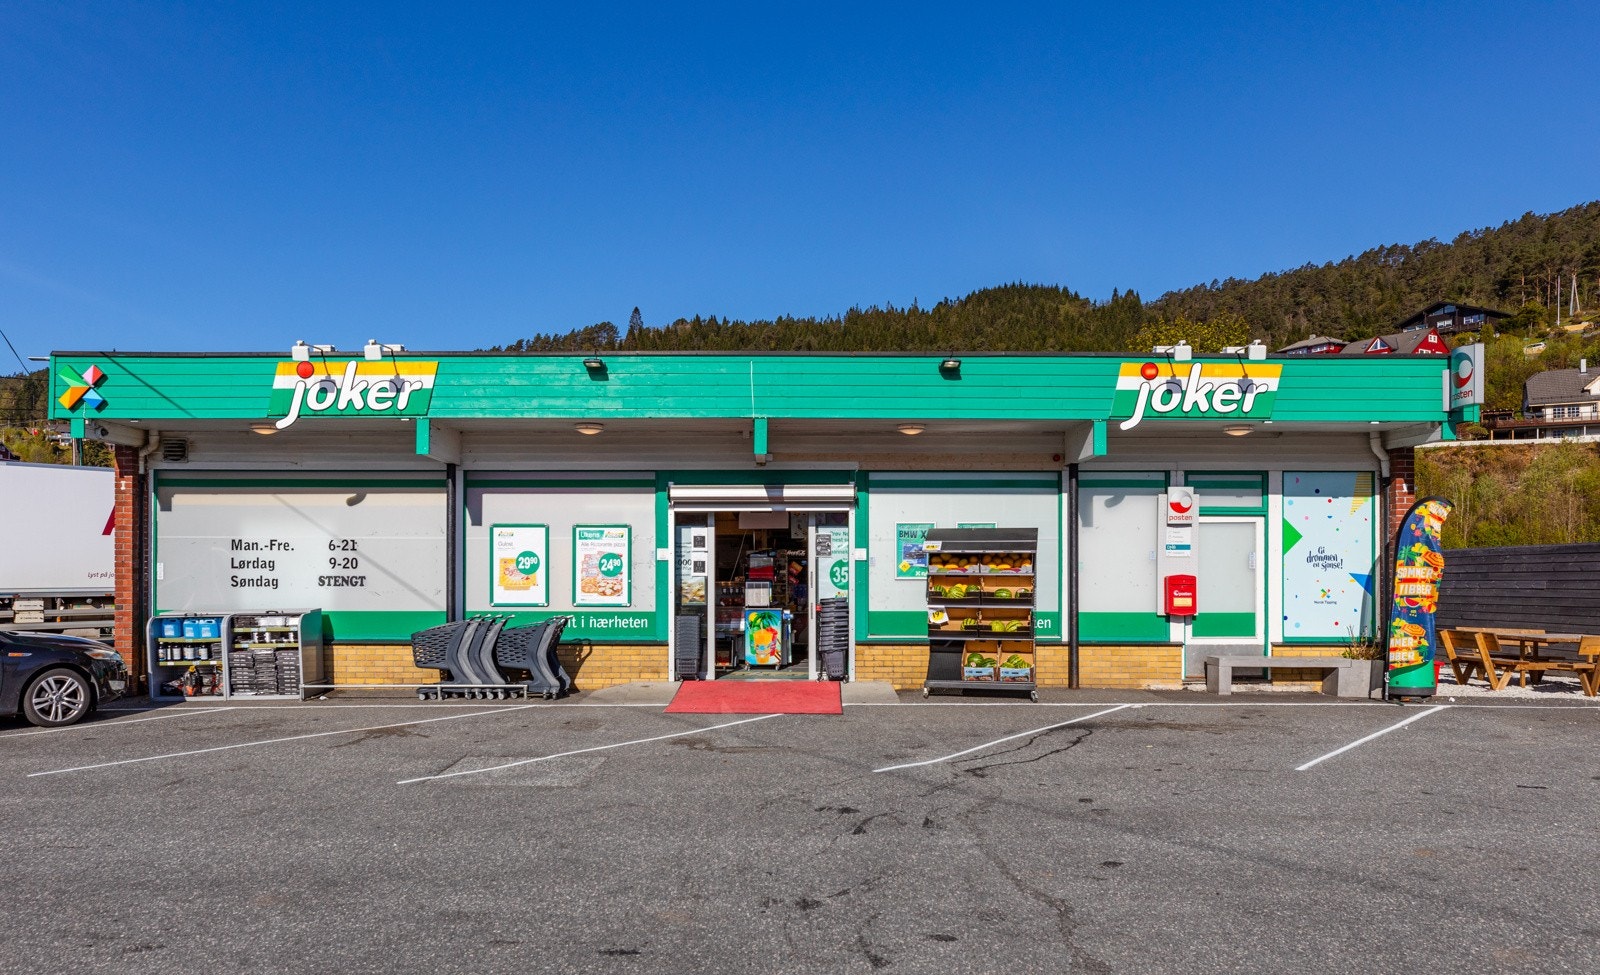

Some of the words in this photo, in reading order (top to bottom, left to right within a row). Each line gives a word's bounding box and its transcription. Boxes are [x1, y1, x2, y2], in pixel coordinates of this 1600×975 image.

[275, 360, 423, 430] joker
[1120, 362, 1269, 430] joker
[1168, 513, 1193, 522] posten
[899, 530, 918, 539] BMW
[231, 539, 295, 551] Man.-Fre.
[328, 539, 357, 551] 6-21
[230, 557, 275, 571] Lørdag
[329, 557, 358, 569] 9-20
[230, 575, 279, 589] Søndag
[318, 575, 366, 587] STENGT
[589, 615, 648, 628] nærheten
